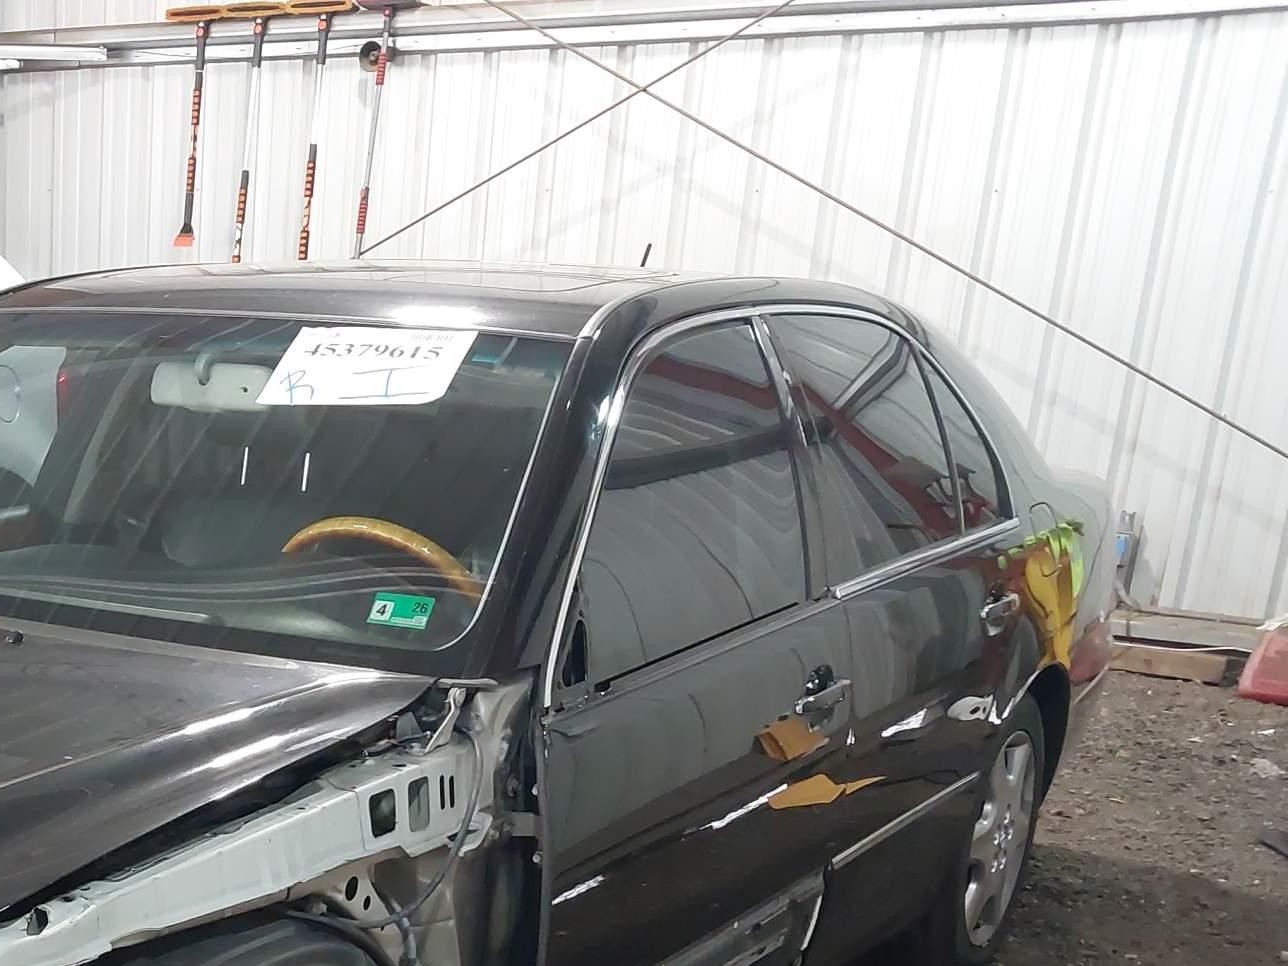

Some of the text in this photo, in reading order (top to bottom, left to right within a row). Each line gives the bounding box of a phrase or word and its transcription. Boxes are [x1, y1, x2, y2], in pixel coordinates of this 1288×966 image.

[304, 343, 444, 359] 45379615
[376, 604, 388, 616] 4
[412, 602, 429, 613] 26
